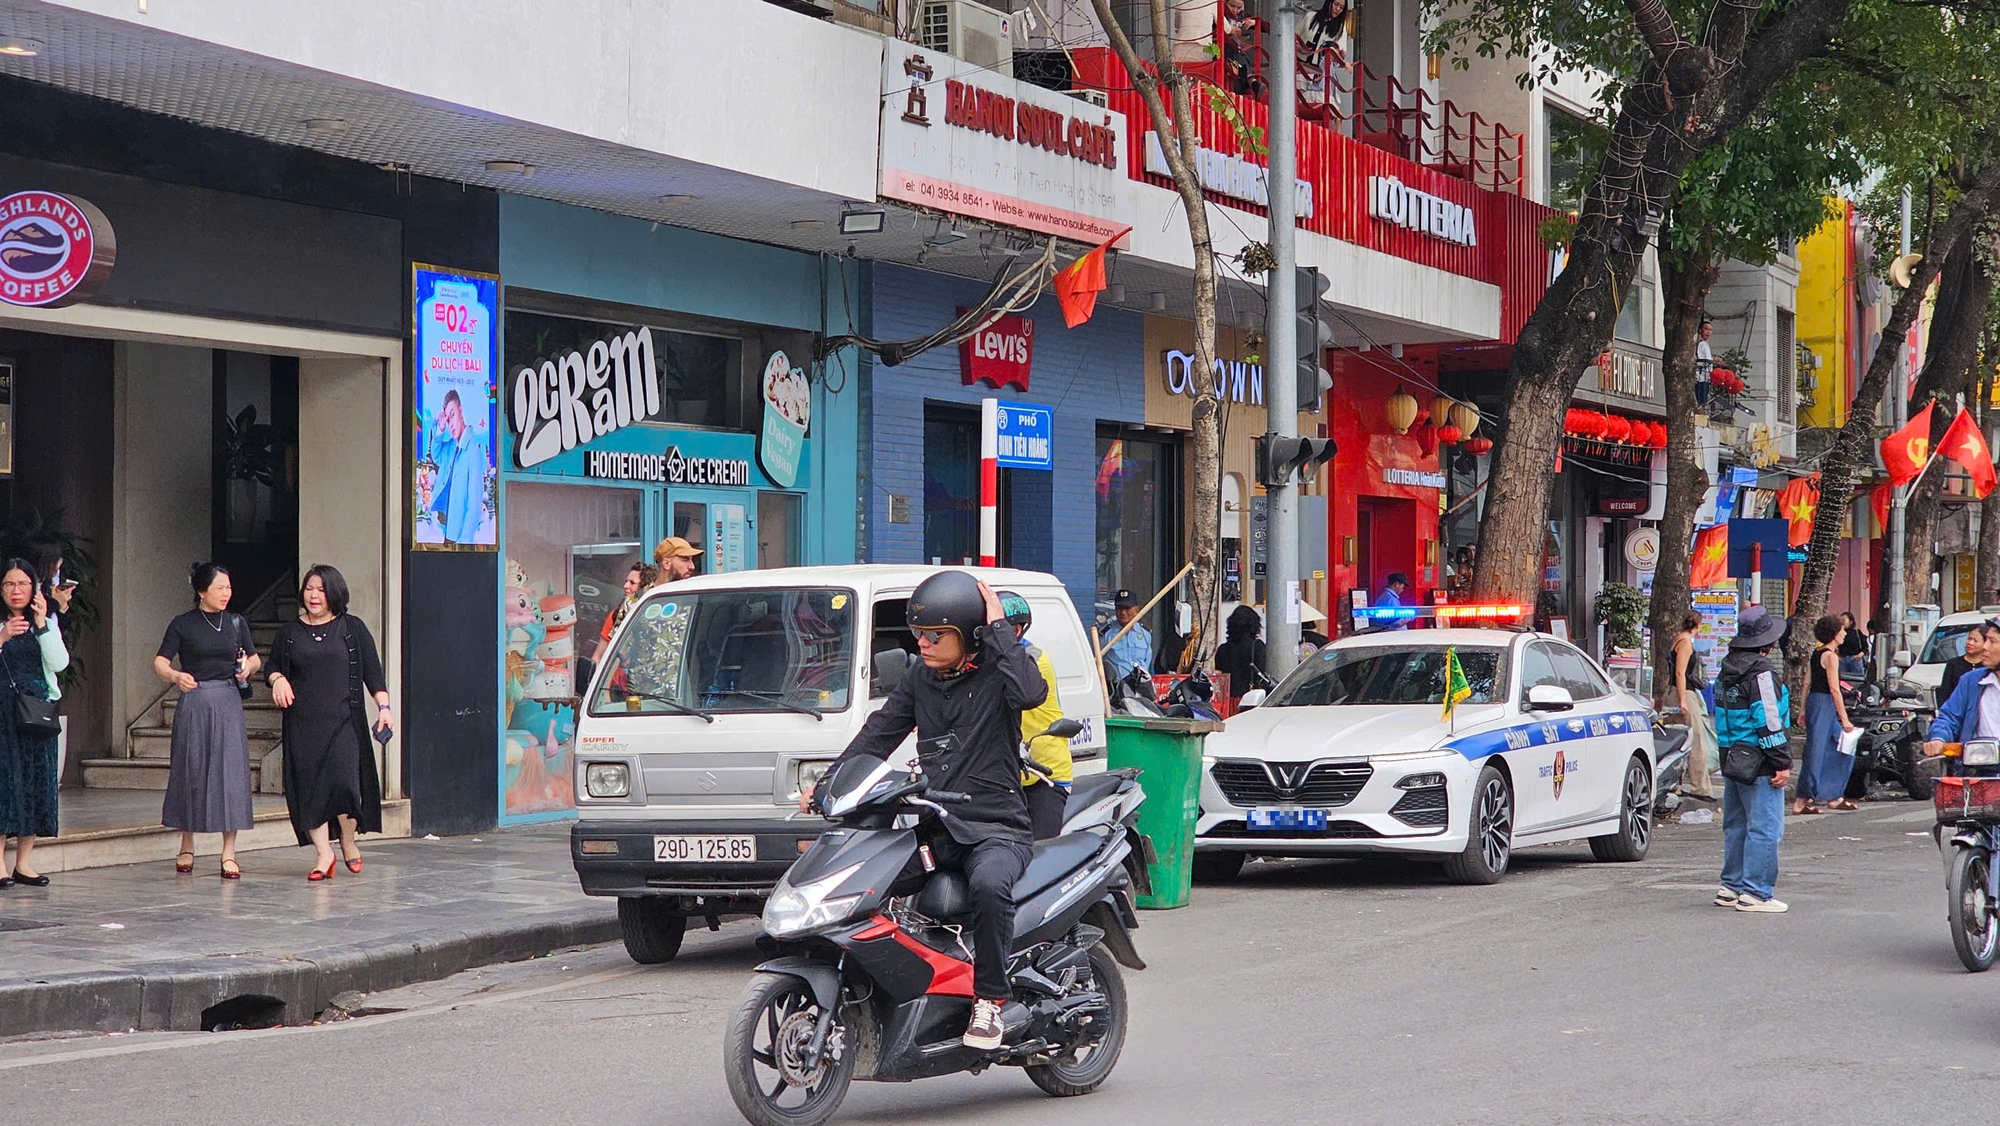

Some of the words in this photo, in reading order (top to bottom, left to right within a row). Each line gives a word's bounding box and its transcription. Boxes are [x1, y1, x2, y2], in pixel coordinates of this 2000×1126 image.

[945, 78, 1016, 141] HANOI
[1016, 101, 1068, 156] SOUL
[1067, 113, 1117, 170] CAFÉ
[937, 187, 960, 203] 3934
[962, 192, 984, 209] 8541
[0, 270, 74, 298] OFFEE
[446, 303, 468, 333] 02
[440, 338, 473, 354] CHUYẾN
[974, 331, 1028, 364] Levi's
[431, 356, 443, 369] DU
[464, 359, 482, 372] BALI
[1018, 411, 1037, 427] PHỐ
[768, 415, 796, 456] Dairy
[590, 450, 666, 482] HOMEMADE
[686, 458, 705, 484] ICE
[706, 458, 749, 486] CREAM
[766, 438, 793, 476] Vegan
[1383, 467, 1420, 486] LOTTERIA
[1610, 502, 1637, 510] WELCOME
[1504, 727, 1531, 750] CẢNH
[1542, 721, 1560, 744] SÁT
[1589, 717, 1609, 737] GIAO
[582, 743, 629, 751] CARRY
[1538, 763, 1553, 779] TRAFFIC
[1565, 759, 1578, 775] POLICE
[657, 837, 752, 860] 29D-125.85
[1060, 868, 1091, 894] BLADE
